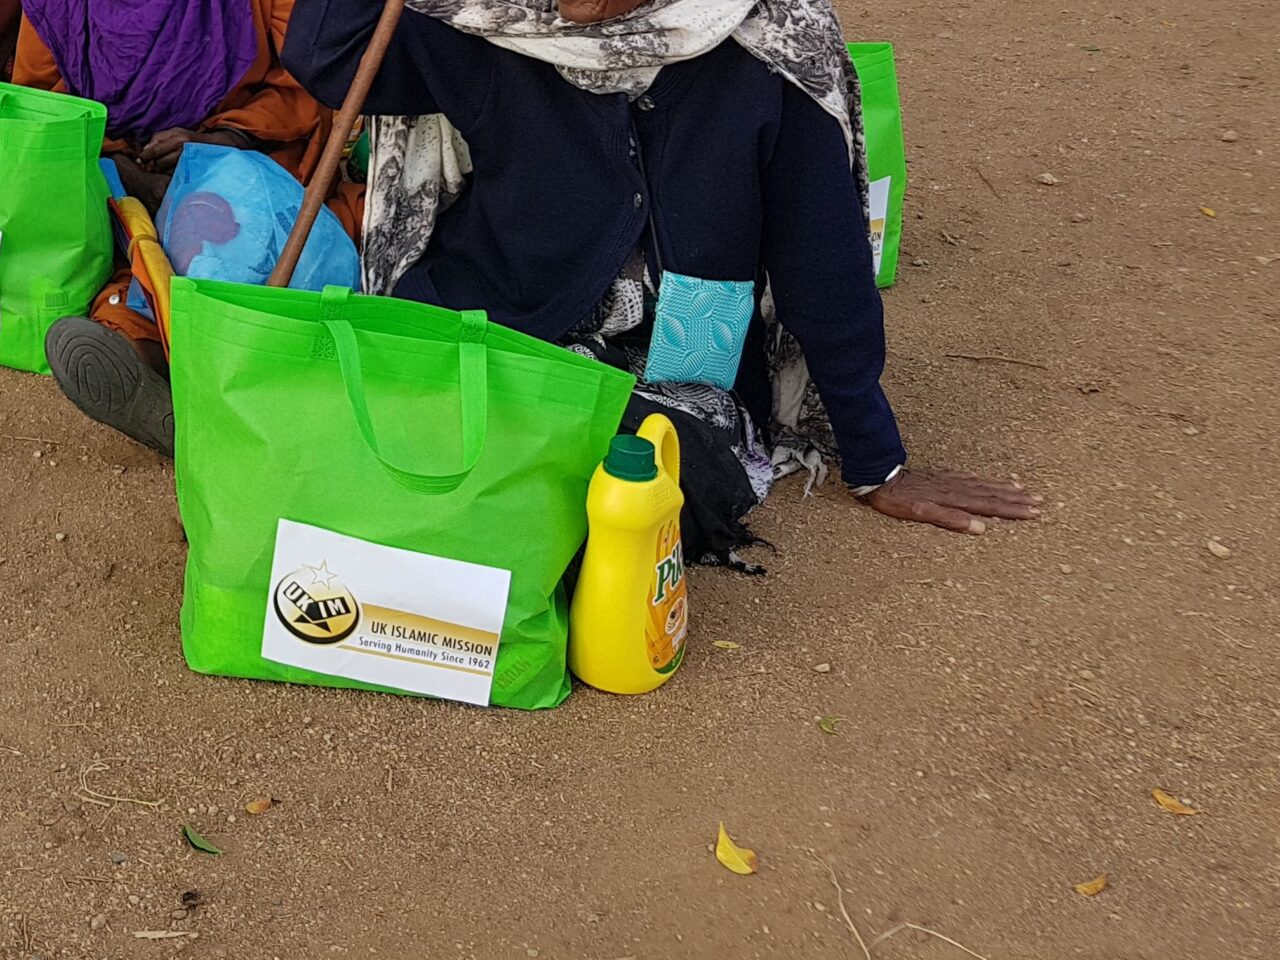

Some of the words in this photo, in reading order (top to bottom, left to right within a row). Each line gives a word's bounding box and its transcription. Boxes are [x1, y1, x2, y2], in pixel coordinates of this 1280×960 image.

[285, 582, 350, 620] UKIM
[359, 636, 392, 653] Serving
[395, 643, 438, 661] Humanity
[441, 651, 464, 665] Since
[468, 656, 490, 669] 1962
[371, 621, 387, 636] UK
[391, 625, 438, 646] ISLAMIC
[442, 636, 492, 656] MISSION
